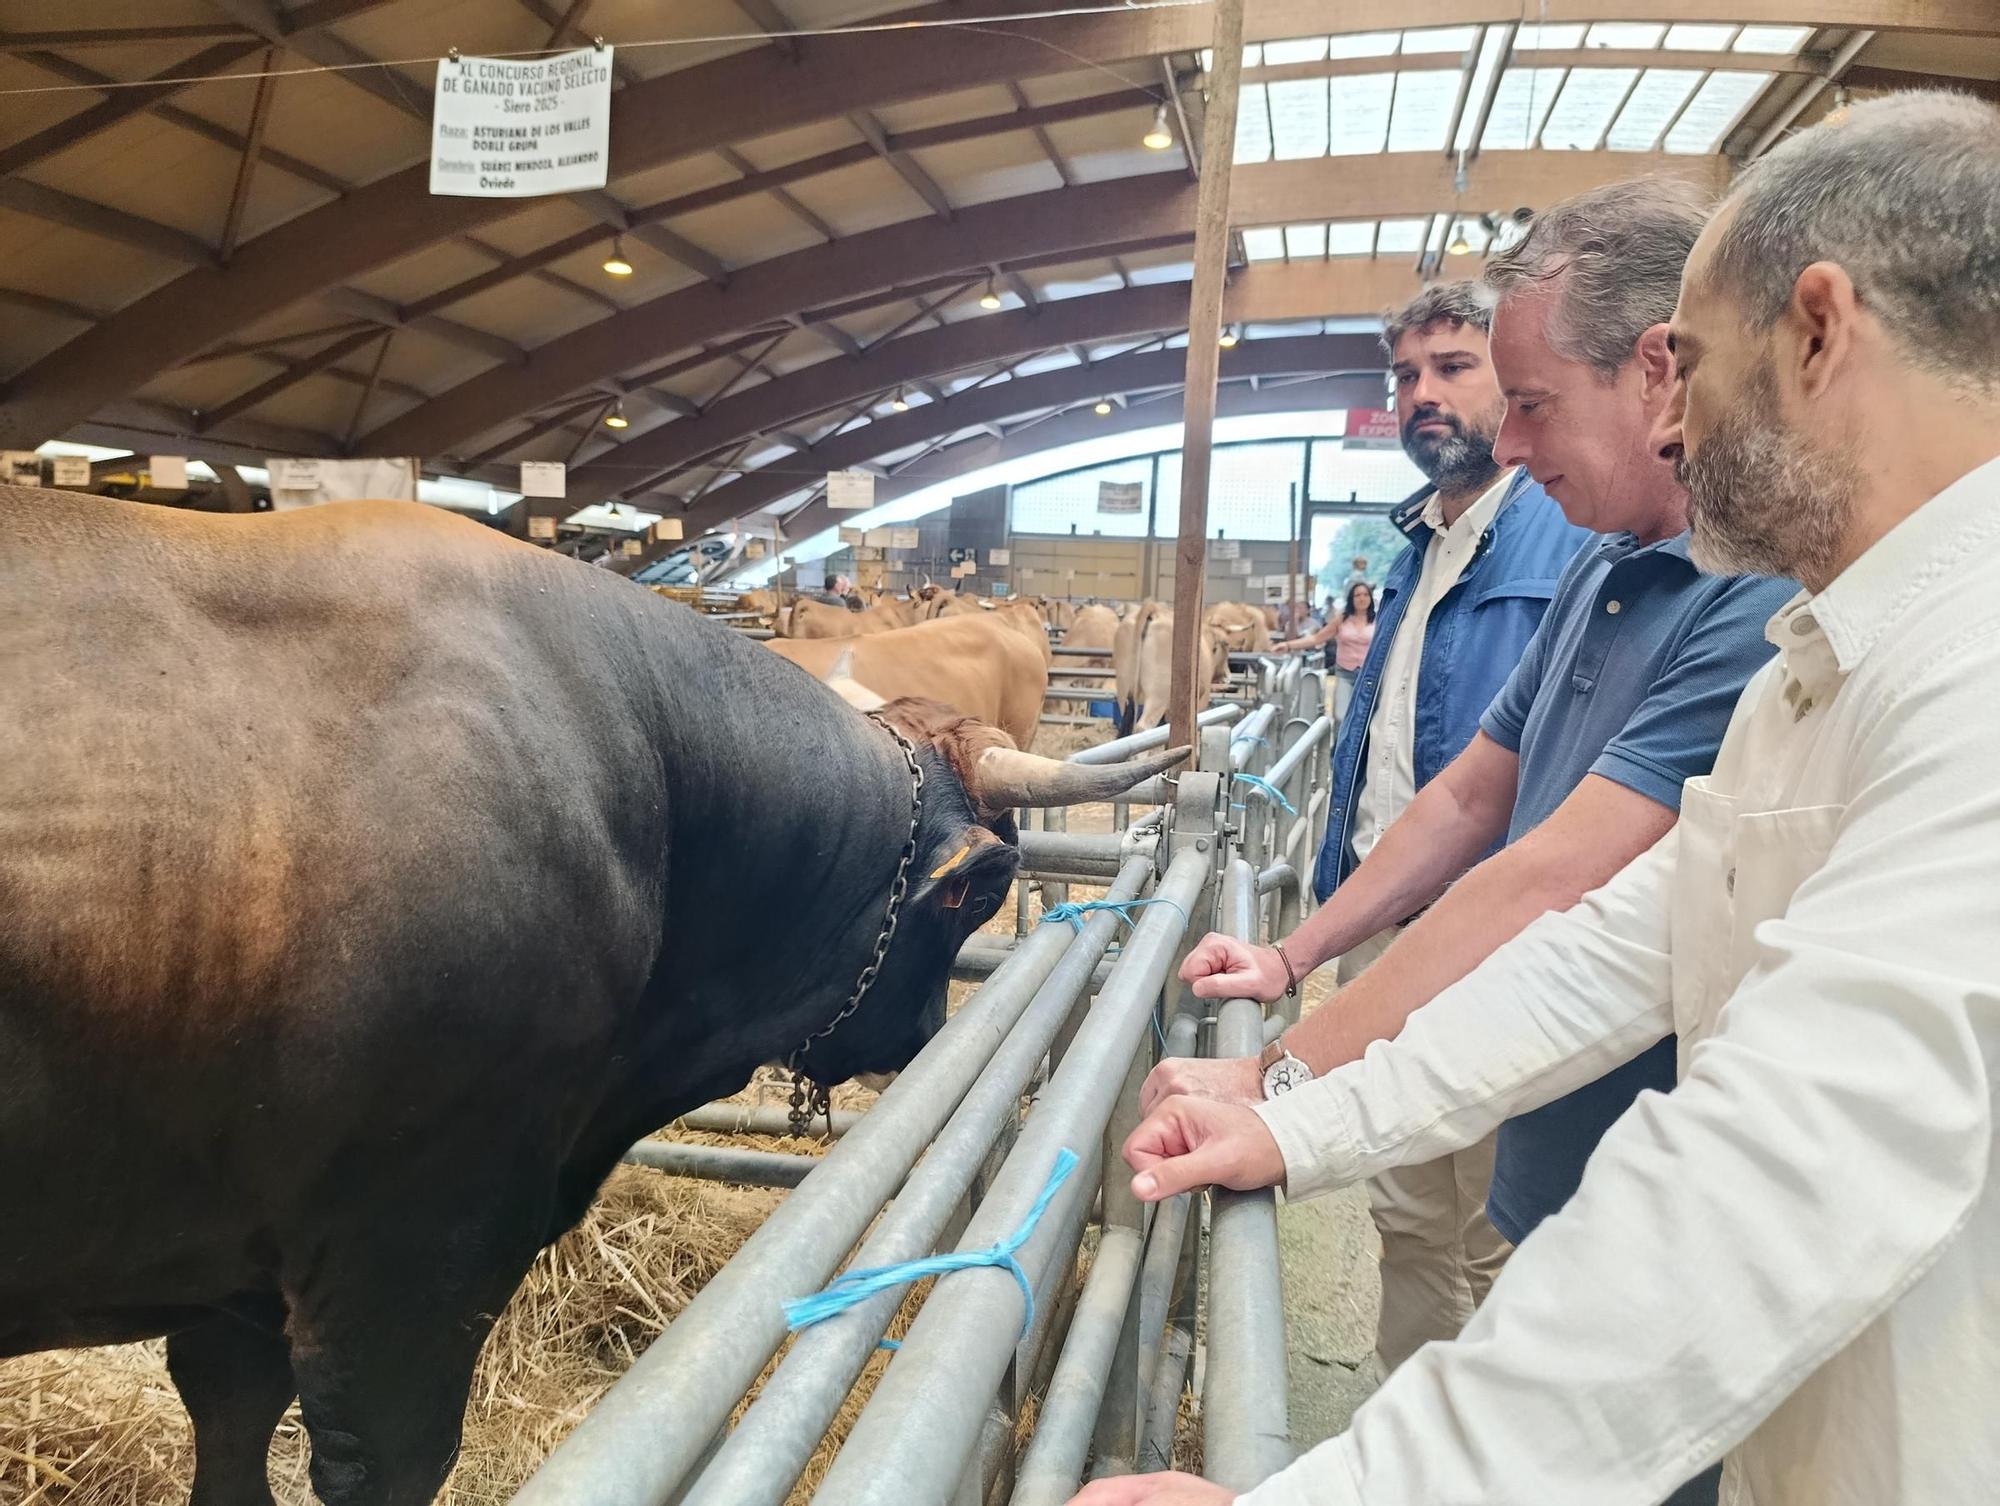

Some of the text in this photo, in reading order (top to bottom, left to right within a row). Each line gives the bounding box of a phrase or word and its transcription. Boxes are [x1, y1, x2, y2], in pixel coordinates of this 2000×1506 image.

[460, 54, 593, 81] XL CONCURSO REGIONAL
[443, 67, 607, 96] DE GANADO VACUNO SELECTO
[503, 99, 531, 113] Siero
[534, 97, 559, 112] 2025
[473, 125, 528, 138] ASTURIANA
[531, 125, 543, 138] DE
[545, 122, 561, 137] LOS
[564, 117, 591, 133] VALLES
[472, 140, 538, 152] DOBLE GRUPA
[557, 151, 599, 168] ALEJANDRO
[480, 176, 516, 190] Oviedo
